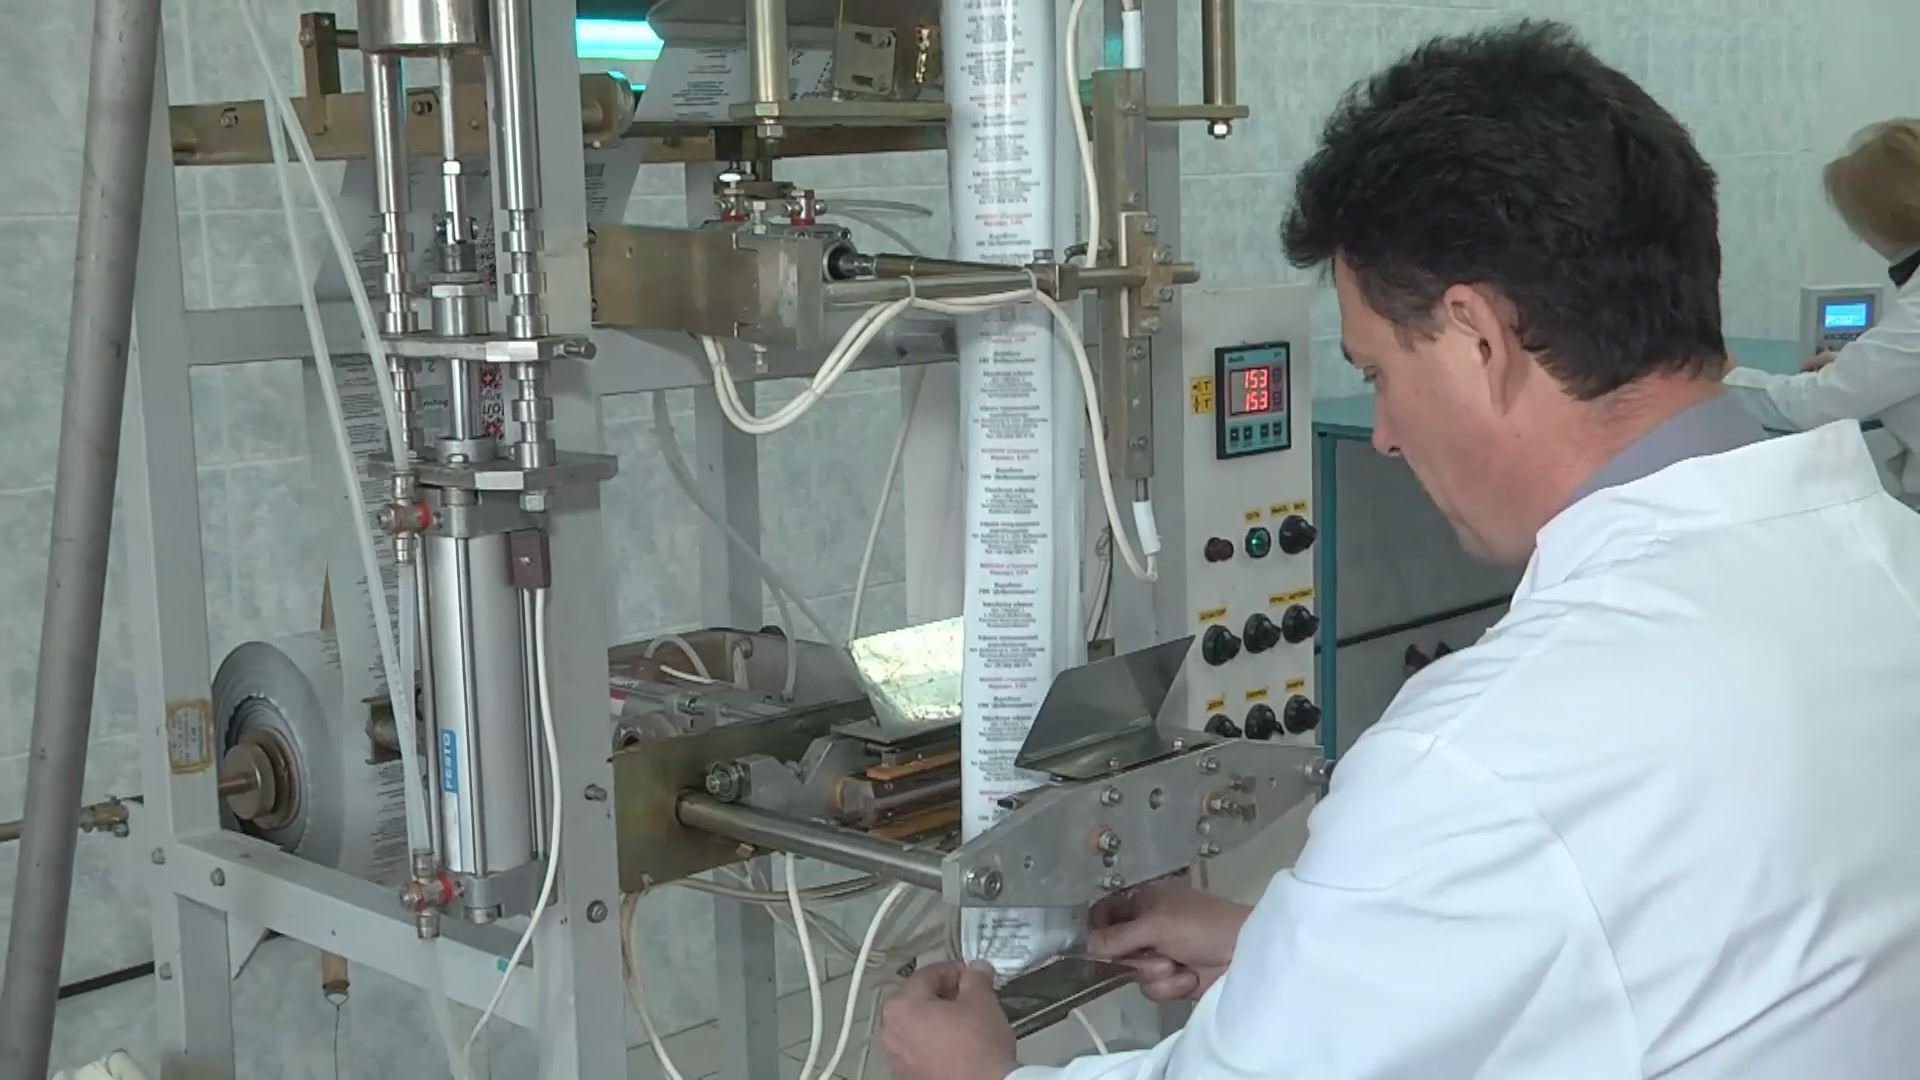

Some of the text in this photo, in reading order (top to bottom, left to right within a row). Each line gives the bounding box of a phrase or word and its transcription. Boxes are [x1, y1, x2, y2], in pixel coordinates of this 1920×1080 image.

[1244, 369, 1268, 389] 153
[1246, 390, 1268, 411] 153
[443, 732, 453, 790] FESTO
